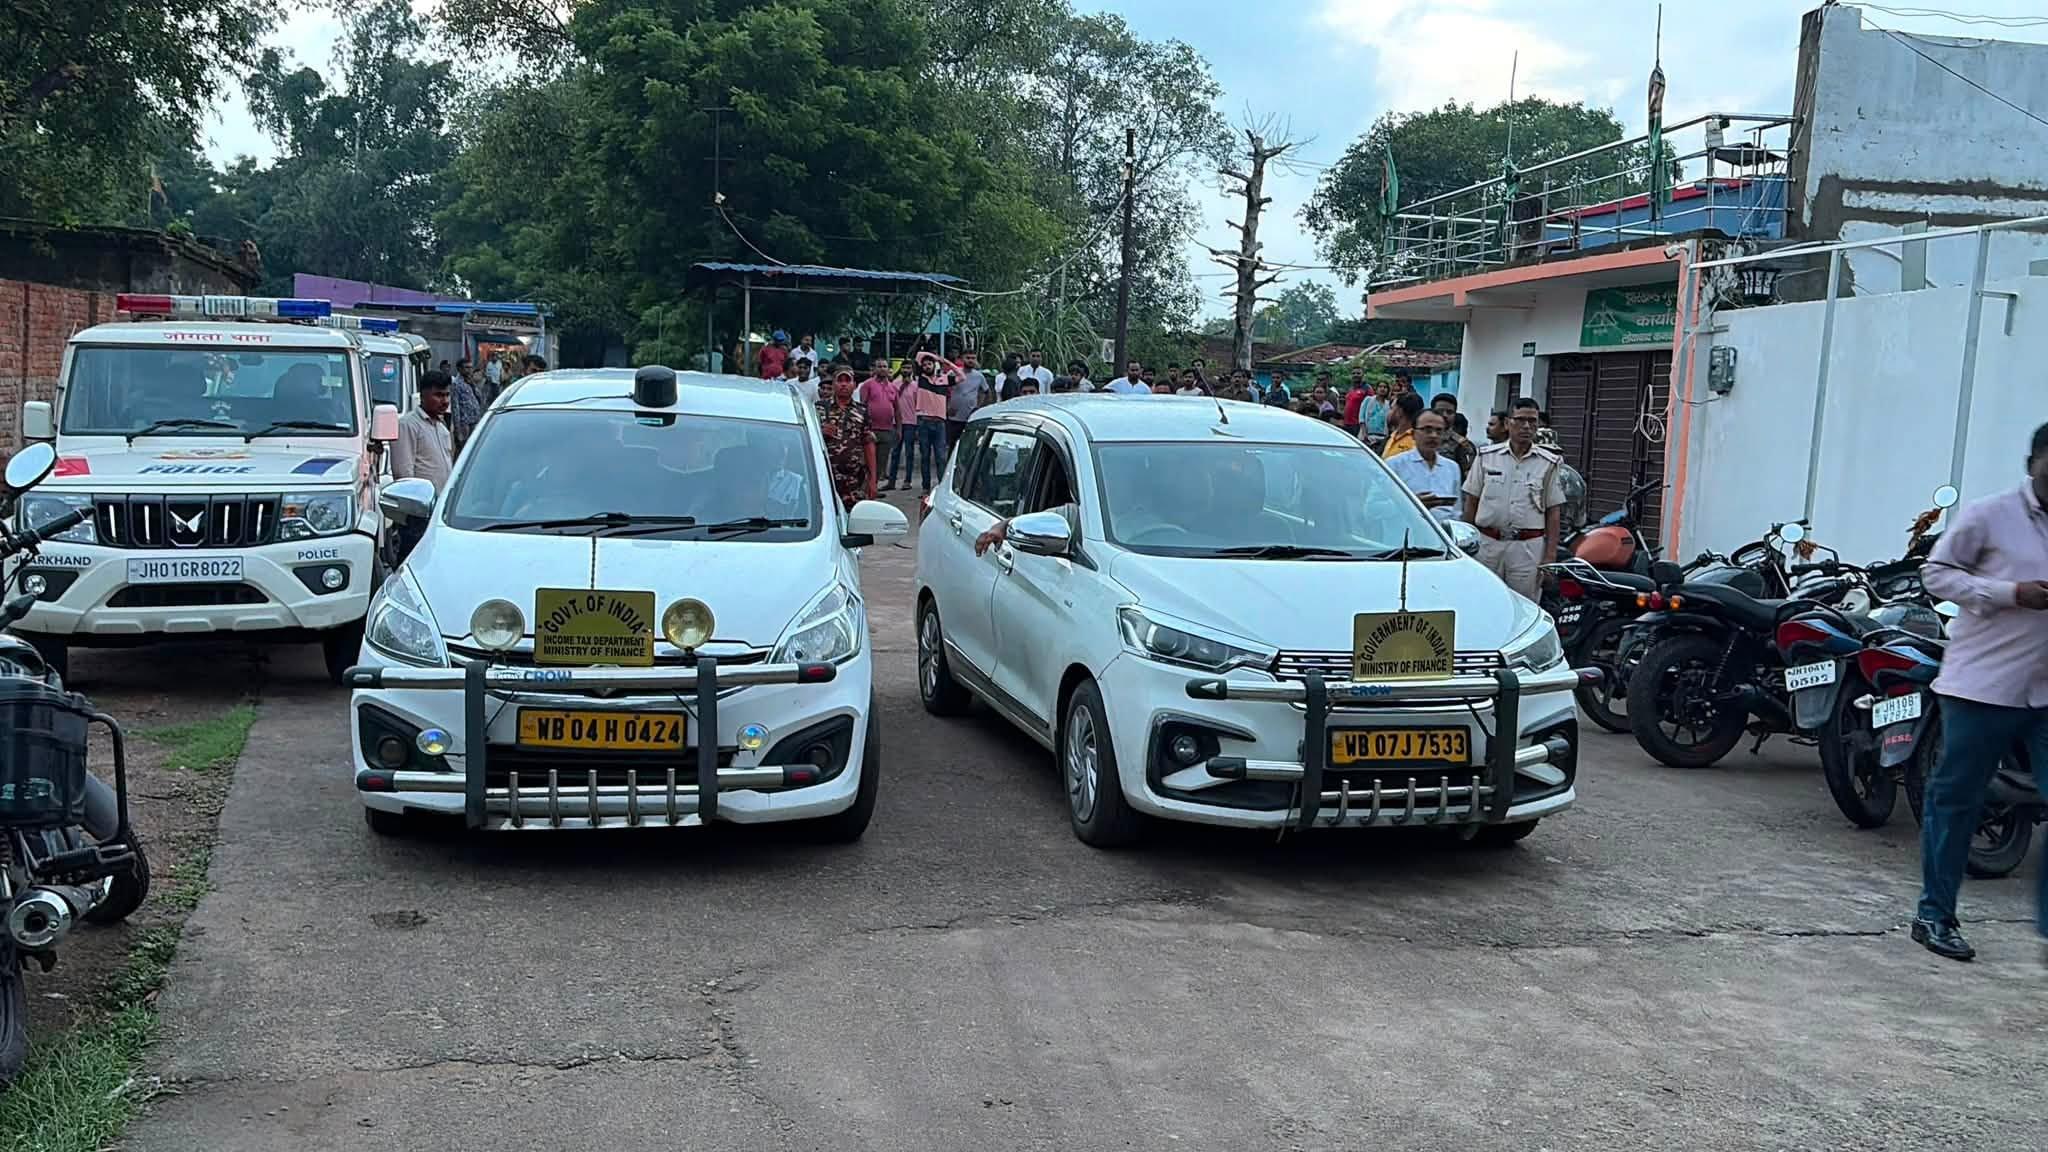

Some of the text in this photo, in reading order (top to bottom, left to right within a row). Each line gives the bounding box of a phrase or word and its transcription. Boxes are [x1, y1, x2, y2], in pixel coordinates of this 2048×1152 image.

[138, 464, 256, 474] POLICE
[298, 549, 339, 560] POLICE
[12, 556, 92, 566] JARKHAND
[139, 561, 240, 579] JH01GR8022
[586, 595, 605, 612] OF
[608, 599, 645, 634] INDIA
[544, 635, 645, 647] INCOME TAX DEPARTMENT
[1360, 615, 1447, 661] GOVERNMENT OF INDIA
[544, 646, 646, 657] MINISTRY OF FINANCE
[1360, 659, 1447, 675] MINISTRY OF FINANCE
[524, 670, 572, 682] CROW
[1351, 685, 1392, 696] CROW
